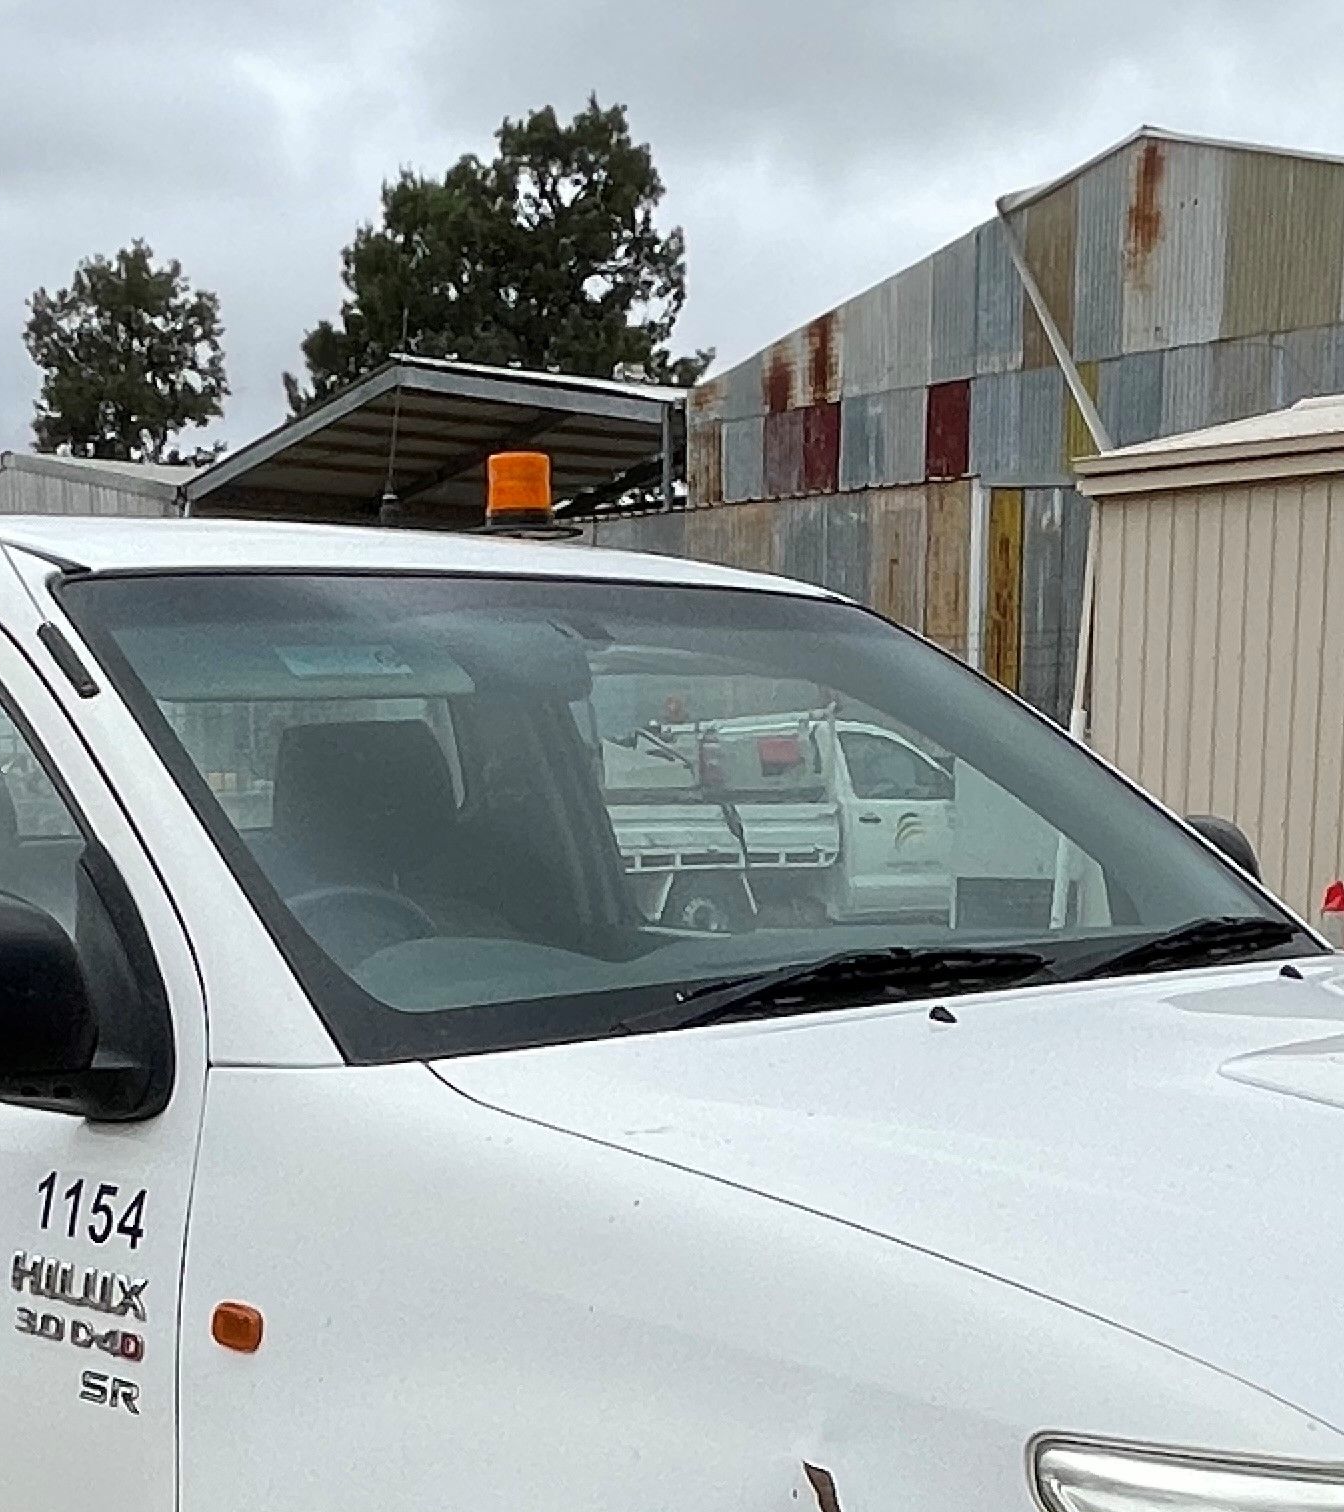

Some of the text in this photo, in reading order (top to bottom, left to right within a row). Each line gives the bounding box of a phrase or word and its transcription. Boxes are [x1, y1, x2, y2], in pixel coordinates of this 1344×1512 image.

[37, 1170, 147, 1250] 1154
[11, 1251, 149, 1323] HILUX
[78, 1370, 140, 1416] SR
